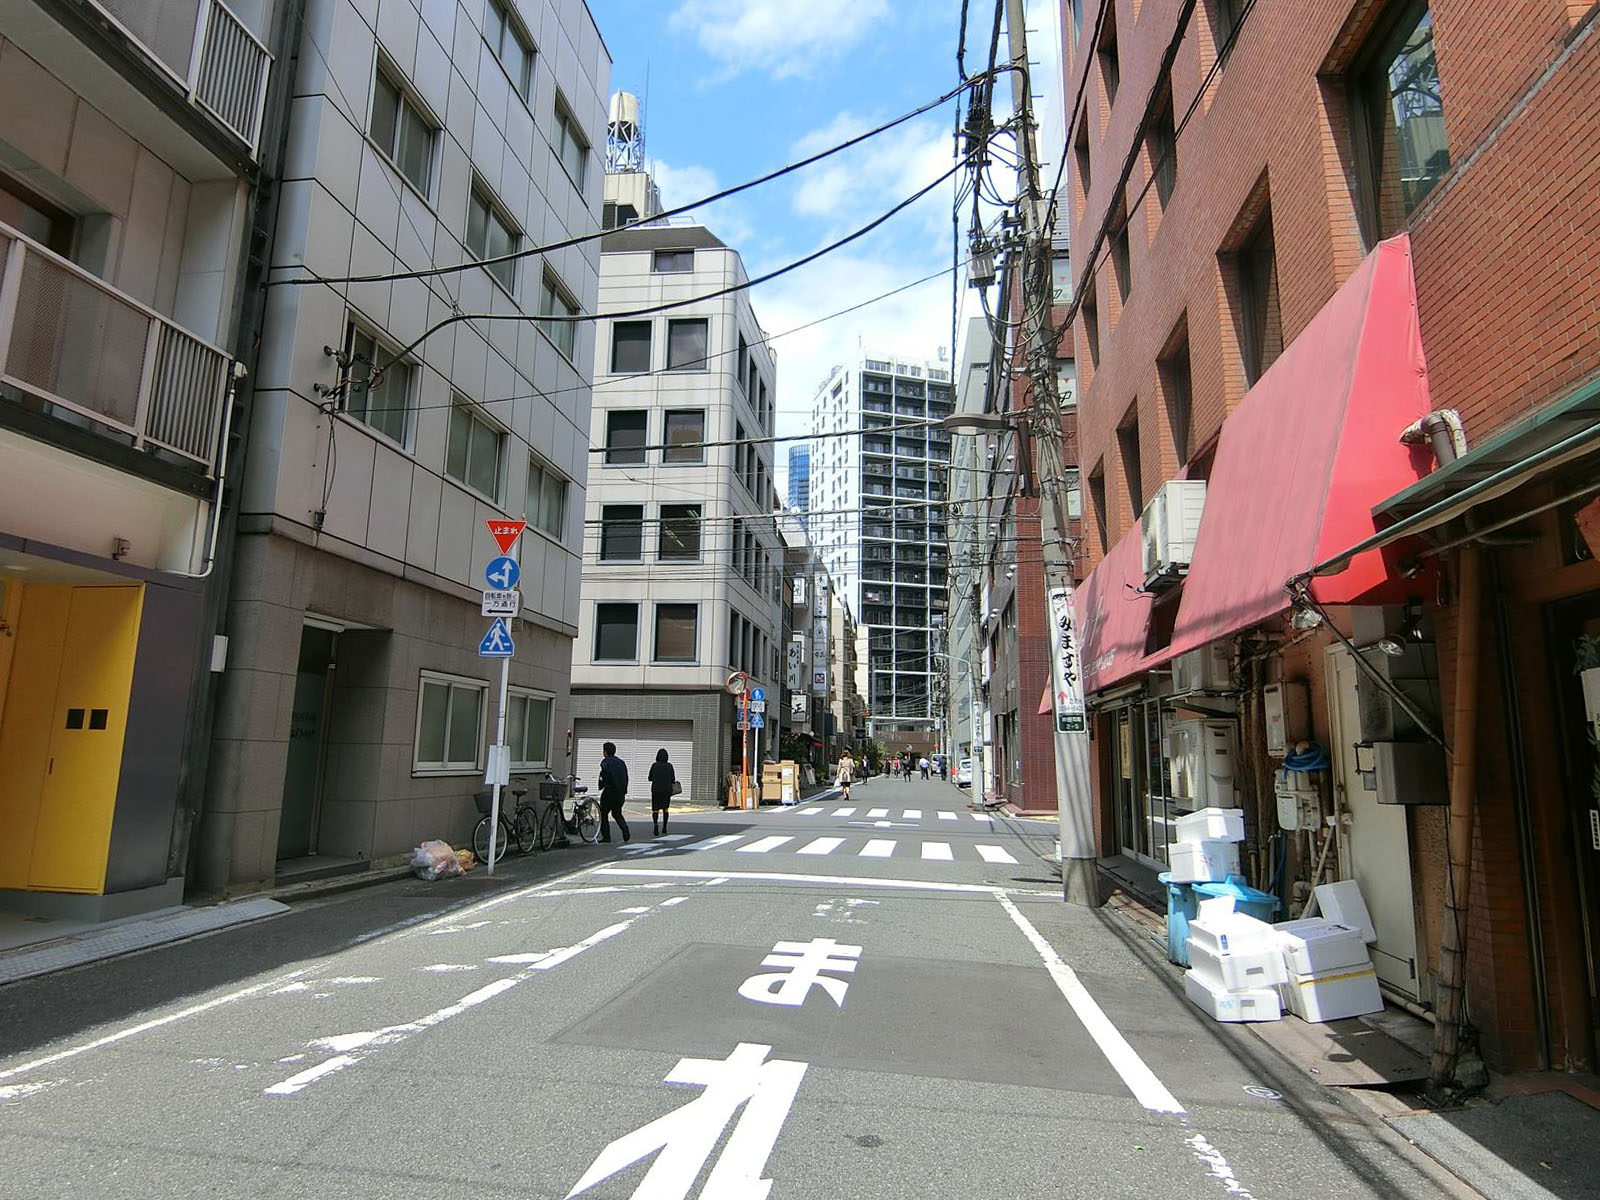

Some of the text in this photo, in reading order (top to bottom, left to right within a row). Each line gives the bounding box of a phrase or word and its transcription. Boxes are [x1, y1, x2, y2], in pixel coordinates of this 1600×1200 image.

[494, 526, 518, 535] 止まれ
[484, 591, 517, 601] 自転車を除く
[484, 600, 516, 609] 一方通行
[1059, 615, 1076, 687] みますや
